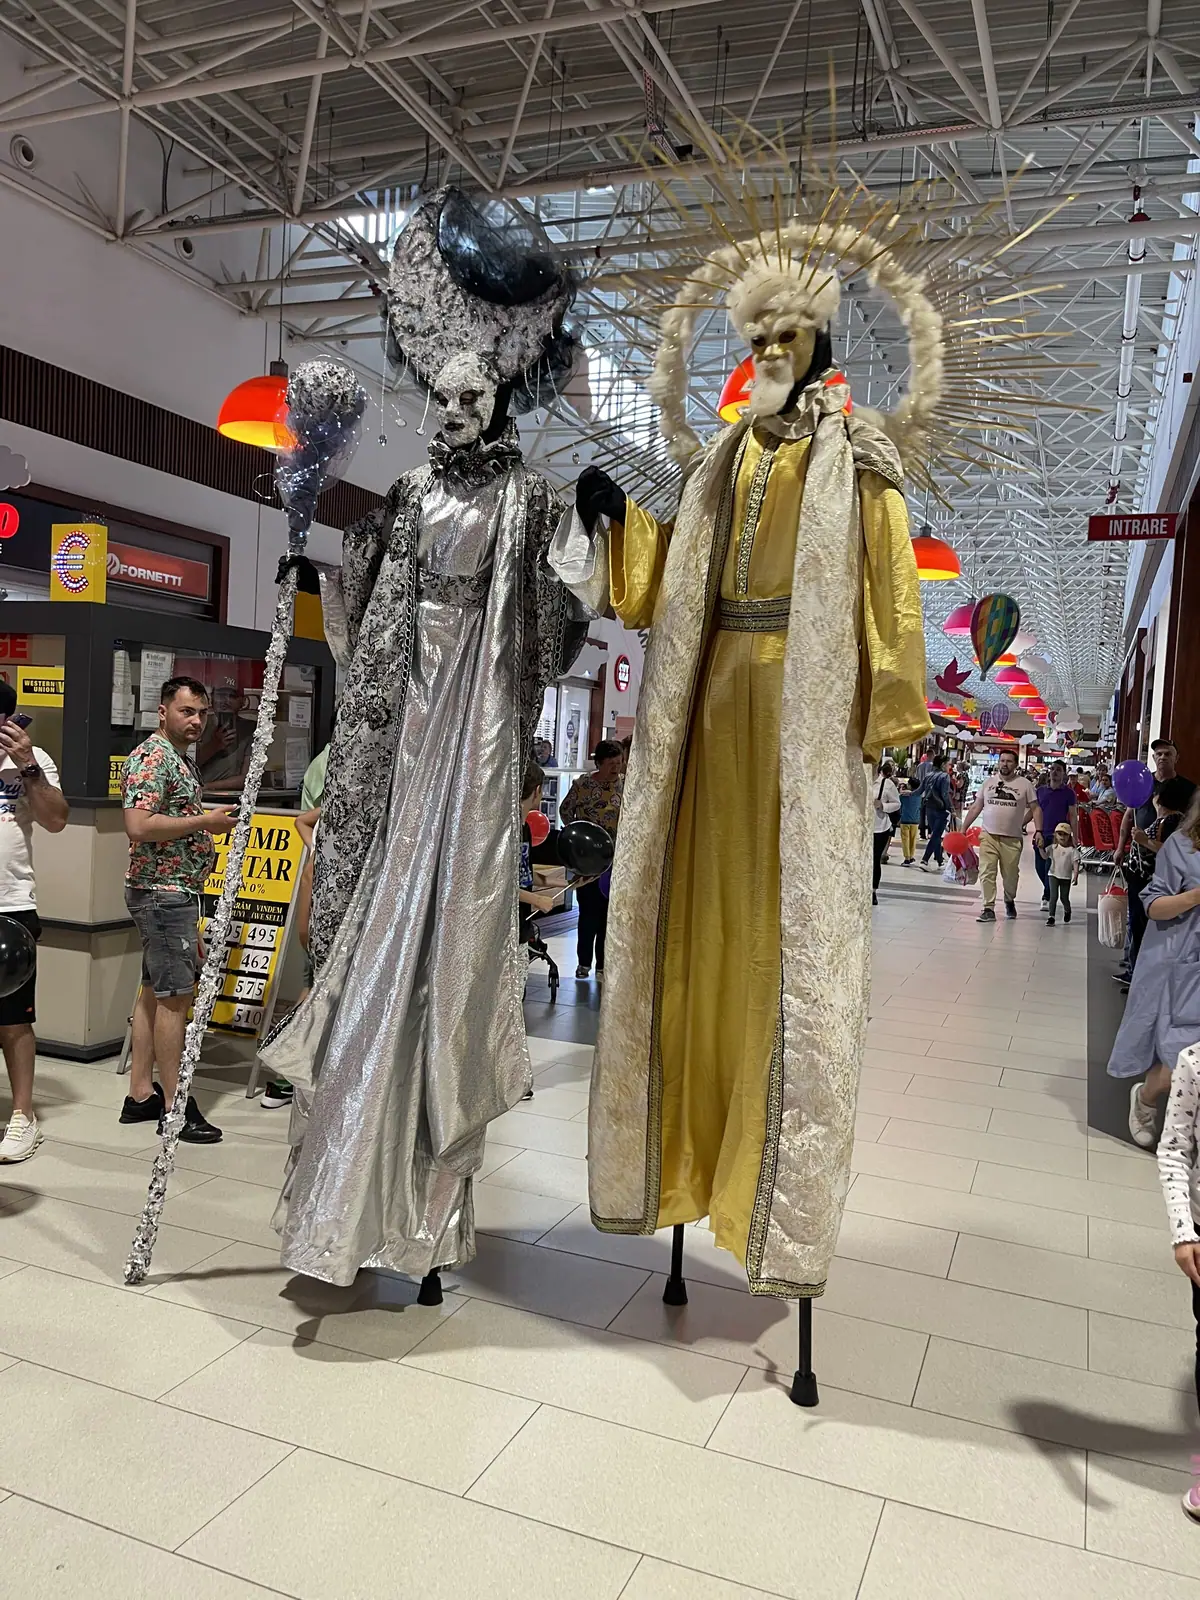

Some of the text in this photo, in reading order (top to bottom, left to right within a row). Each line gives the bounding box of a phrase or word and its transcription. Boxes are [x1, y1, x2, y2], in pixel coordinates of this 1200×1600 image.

[1108, 518, 1169, 537] INTRARE
[119, 563, 184, 587] FORNETTI
[249, 883, 266, 895] 0%
[256, 904, 284, 914] VINDEM
[248, 927, 277, 942] 495
[241, 953, 270, 970] 462
[235, 980, 264, 997] 575
[234, 1009, 262, 1024] 510
